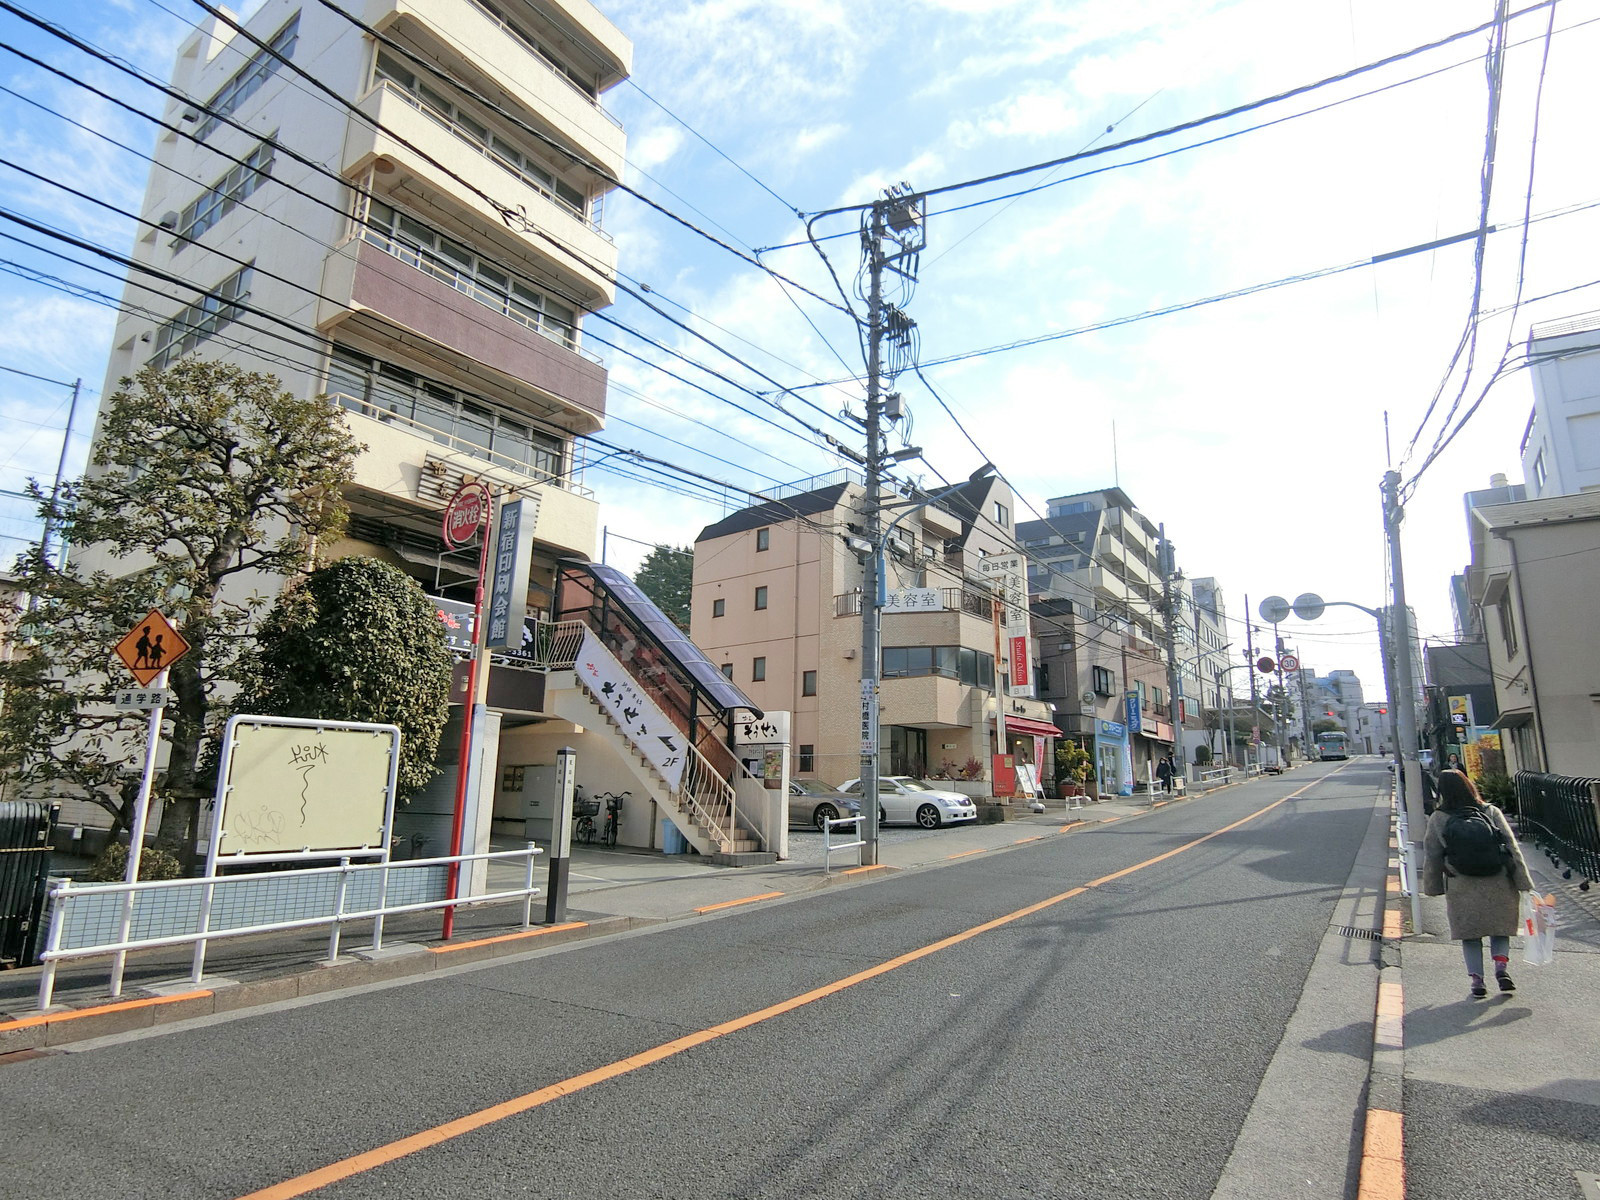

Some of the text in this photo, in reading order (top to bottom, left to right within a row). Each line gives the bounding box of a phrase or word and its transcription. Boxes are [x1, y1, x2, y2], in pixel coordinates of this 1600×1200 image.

[452, 505, 479, 529] 消火栓
[982, 560, 1018, 572] 毎日営業
[490, 509, 518, 641] 新宿印刷会館
[886, 592, 936, 608] 美容室
[1008, 577, 1022, 622] 美容室
[1284, 659, 1294, 668] 30
[121, 693, 162, 704] 通学路
[744, 722, 778, 740] そうせき
[662, 757, 679, 767] 2F
